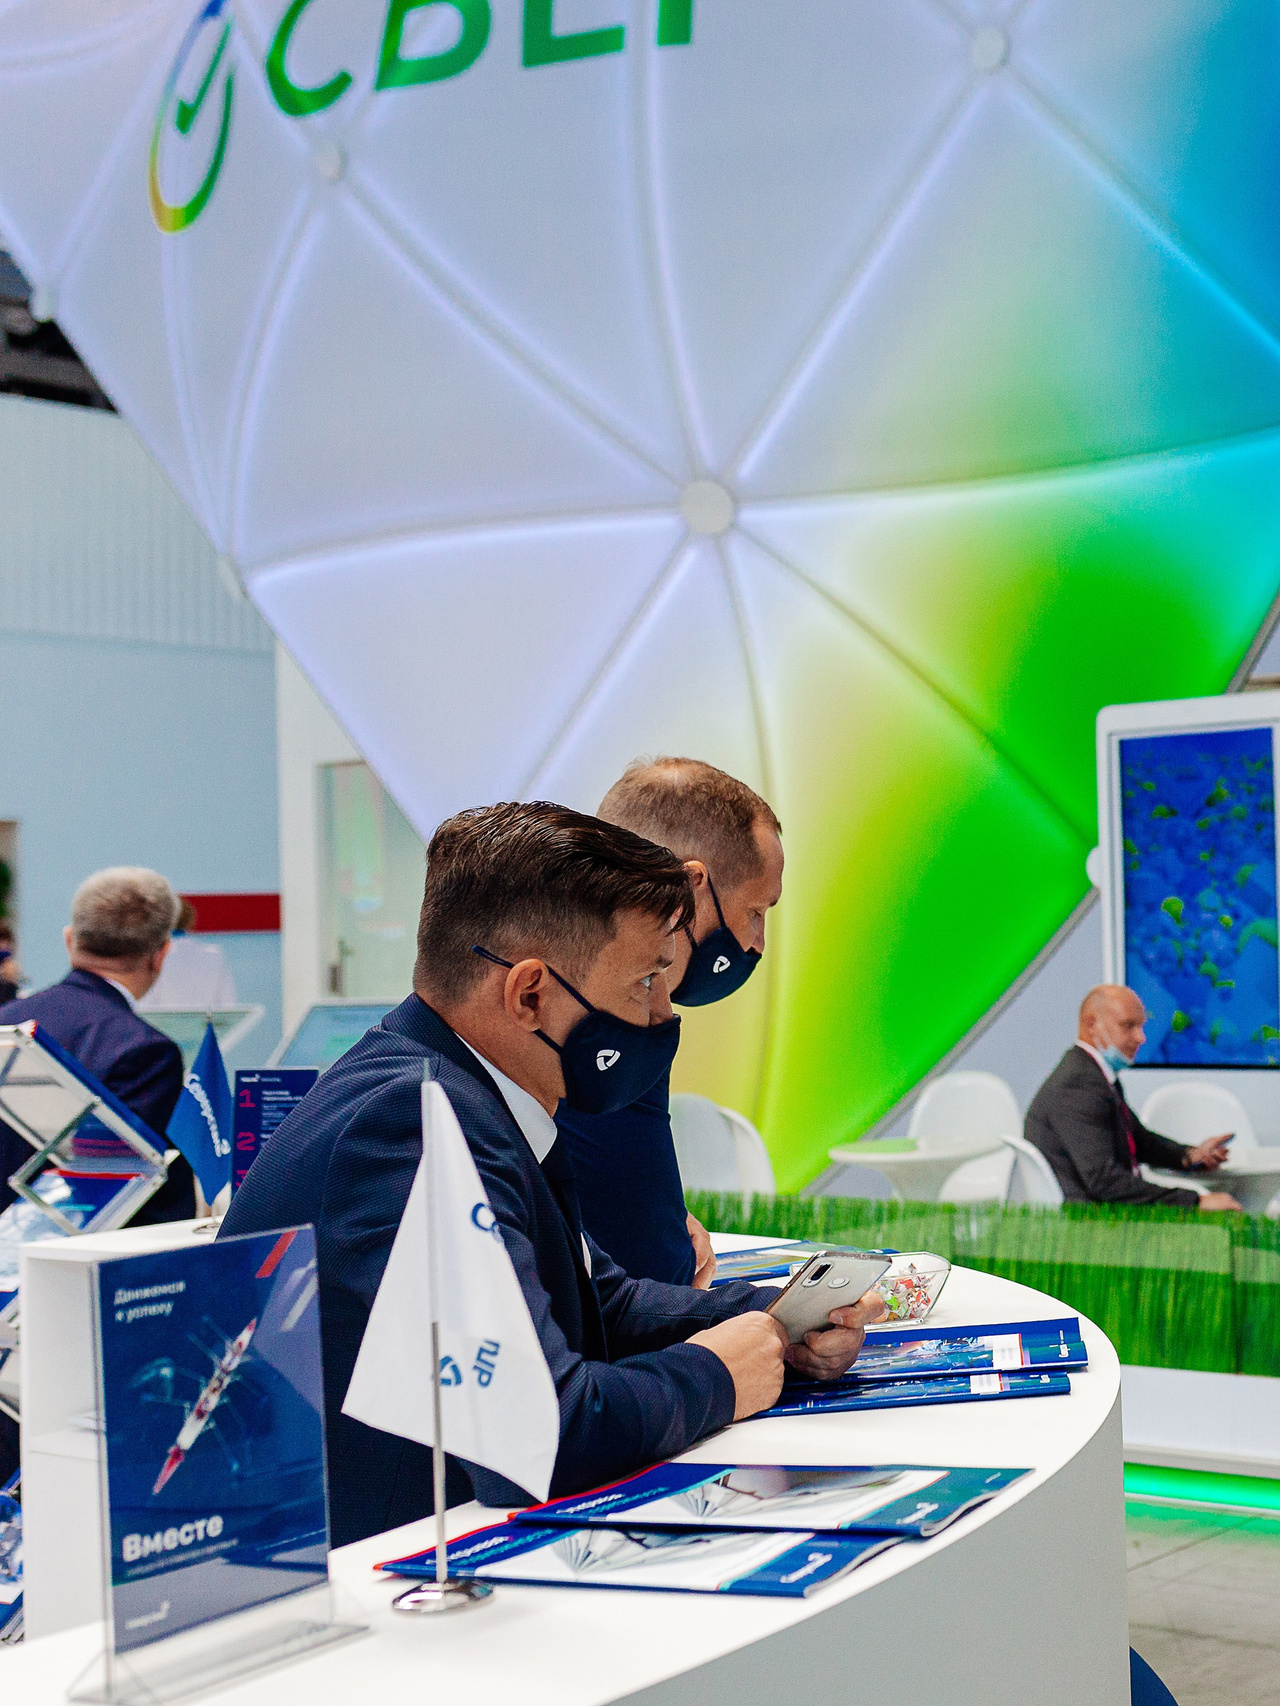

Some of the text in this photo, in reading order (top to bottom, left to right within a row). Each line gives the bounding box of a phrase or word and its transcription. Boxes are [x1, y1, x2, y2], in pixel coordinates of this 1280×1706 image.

[265, 0, 693, 117] СБ
[239, 1089, 256, 1108] 1
[236, 1131, 255, 1151] 2
